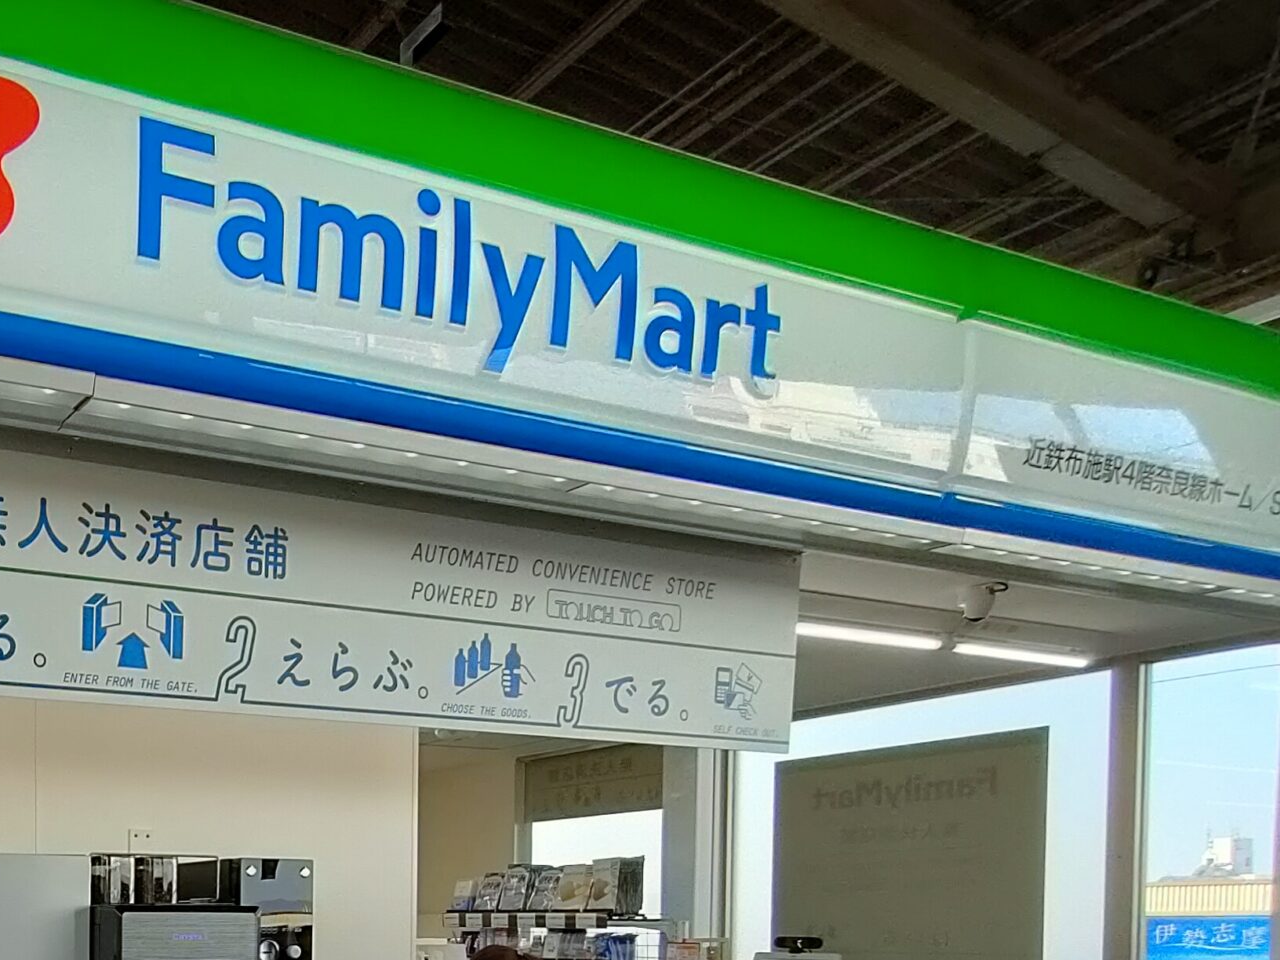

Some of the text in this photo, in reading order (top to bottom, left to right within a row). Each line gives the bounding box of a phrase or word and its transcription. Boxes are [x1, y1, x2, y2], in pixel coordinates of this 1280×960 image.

[137, 115, 782, 382] FamilyMart
[411, 541, 717, 601] AUTOMATED CONVENIENCE STORE
[411, 581, 676, 633] POWERED BY TOUCH TO GO
[63, 672, 198, 693] ENTER FROM THE GATE.
[276, 637, 429, 700] えらぶ。
[441, 702, 532, 719] CHOOSE THE GOODS.
[605, 674, 689, 722] でる。
[713, 724, 733, 735] SELF
[735, 726, 759, 737] CHECK
